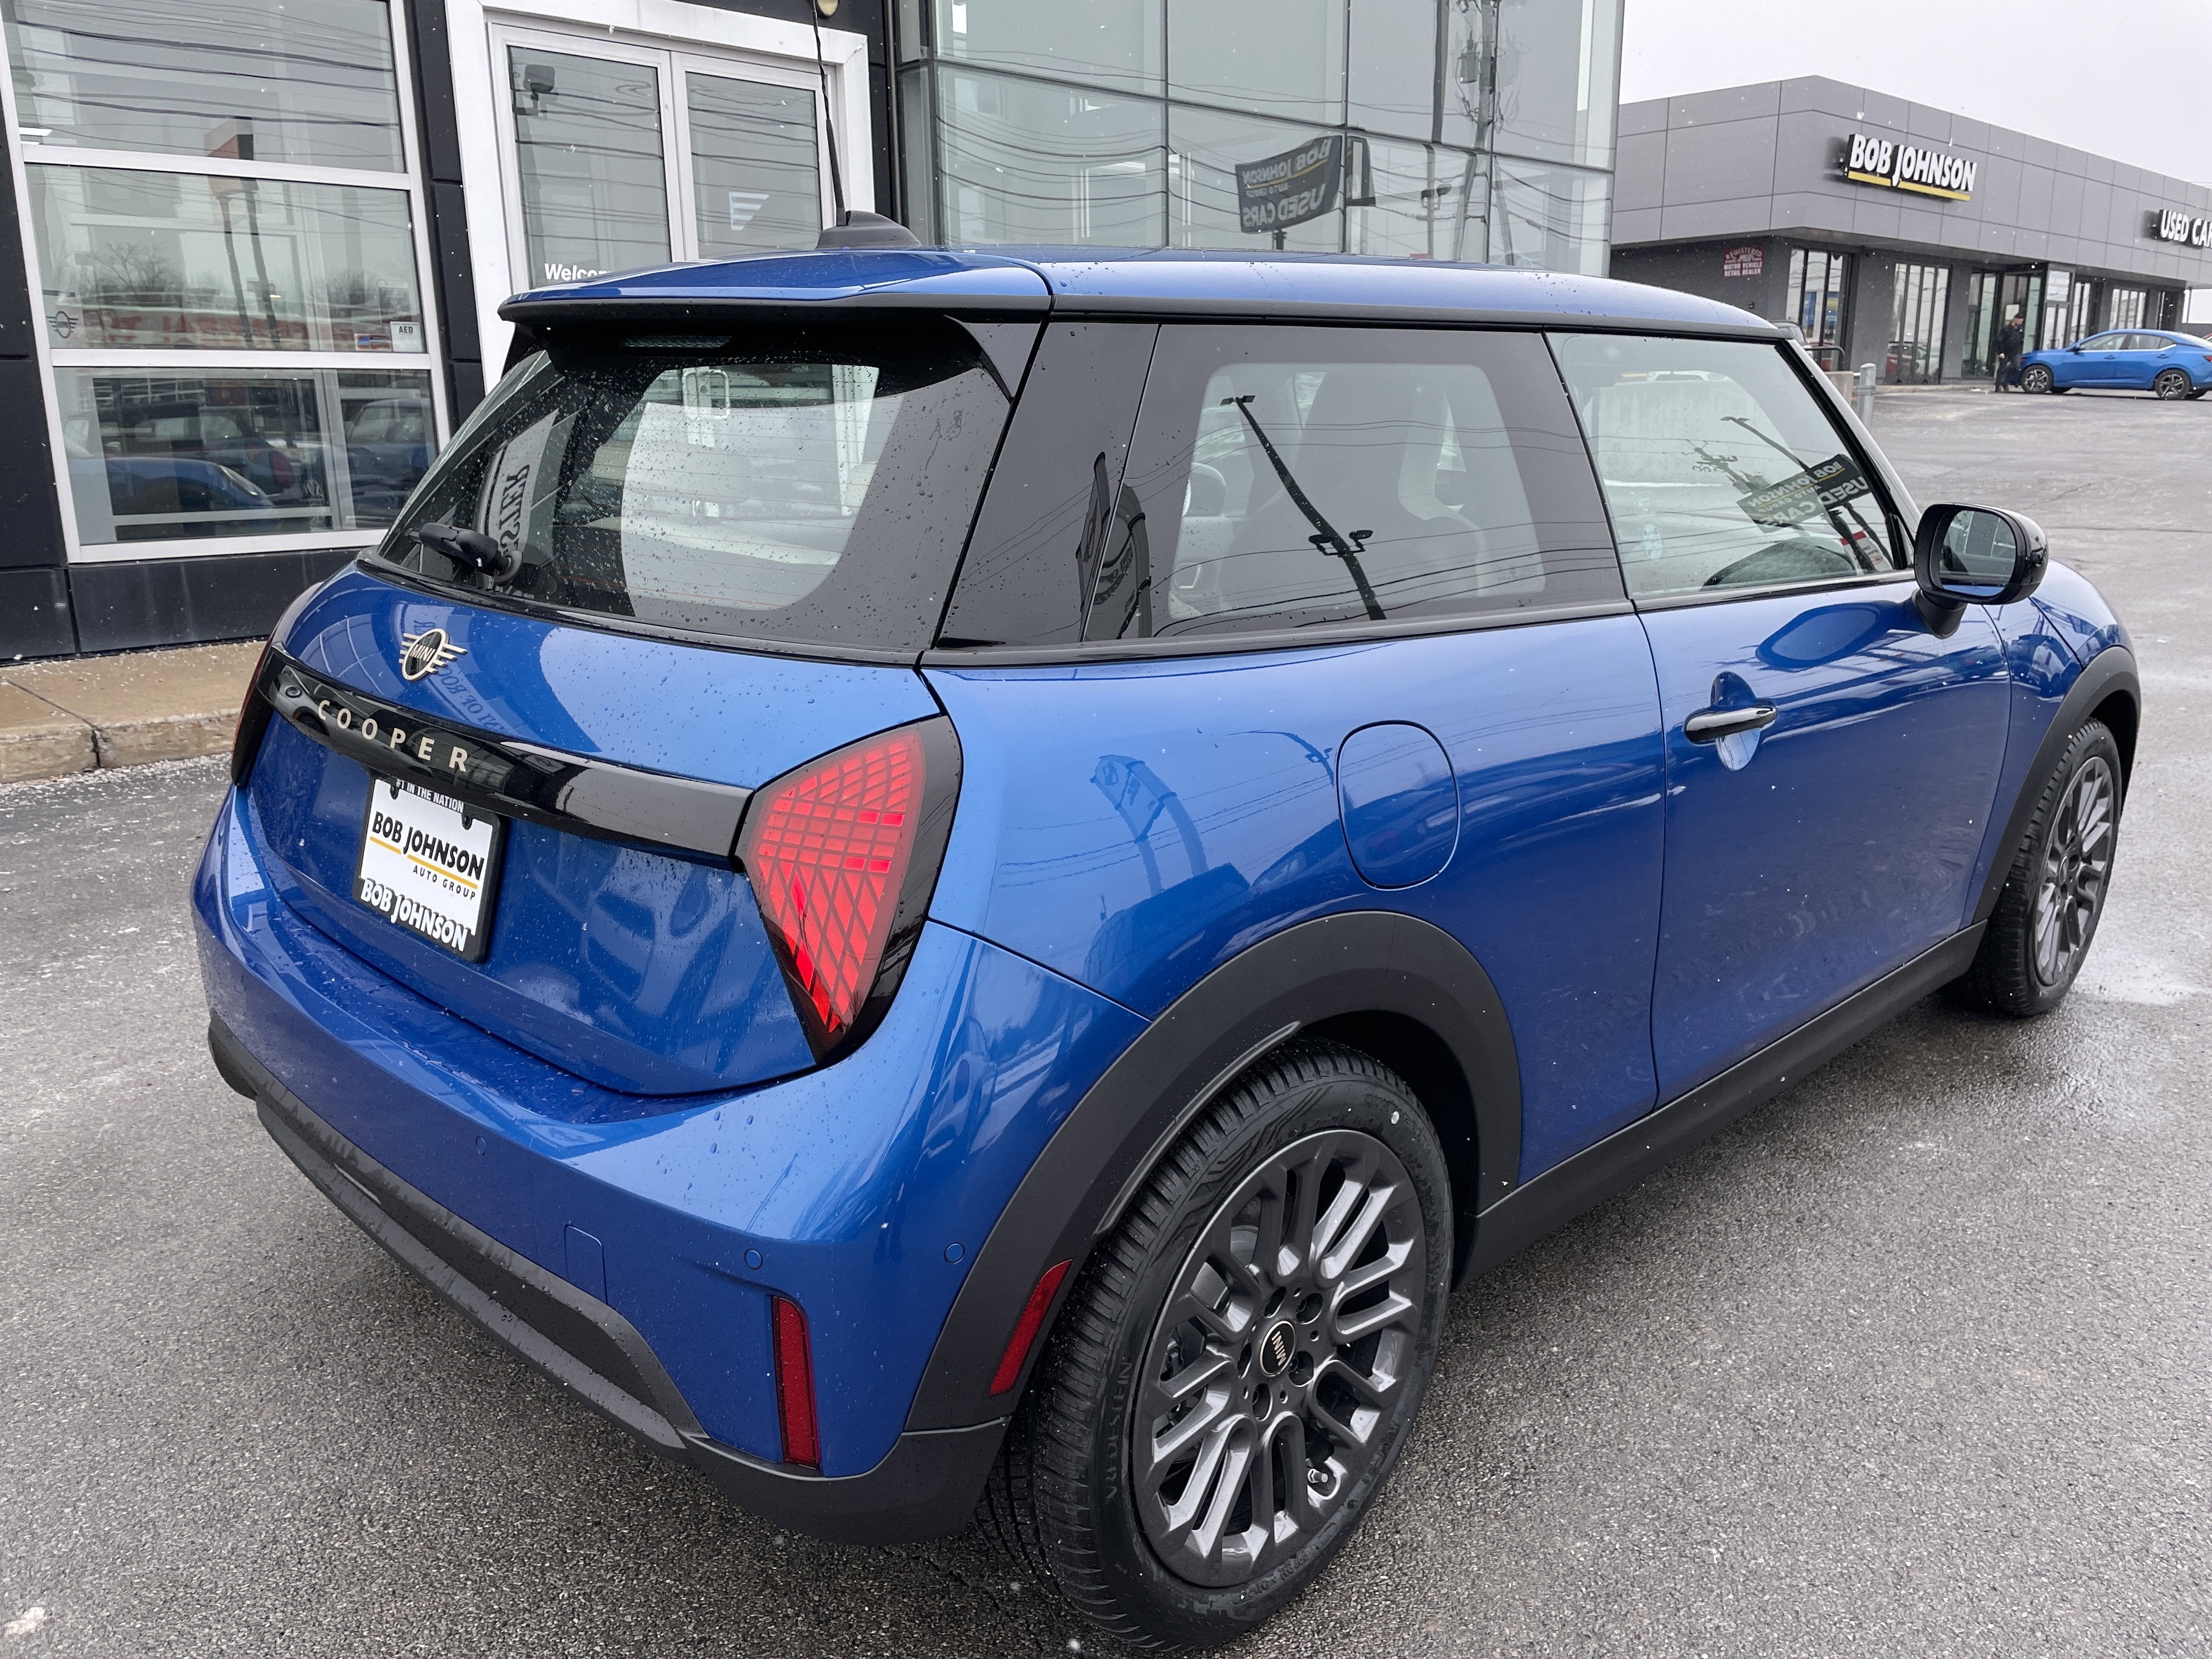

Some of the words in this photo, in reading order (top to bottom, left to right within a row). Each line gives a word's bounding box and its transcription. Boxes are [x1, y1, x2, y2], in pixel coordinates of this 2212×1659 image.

[1849, 133, 1892, 174] BOB
[1892, 144, 1977, 191] JOHNSON
[2160, 209, 2189, 242] USED
[410, 644, 436, 662] MINI
[318, 699, 468, 772] COOPER
[396, 778, 405, 789] #1
[407, 780, 415, 794] IN
[417, 785, 431, 800] THE
[433, 791, 465, 813] NATION
[372, 811, 403, 843] BOB
[403, 826, 485, 881] JOHNSON
[413, 865, 437, 883] AUTO
[443, 878, 476, 900] GROUP
[360, 878, 394, 912] BOB
[391, 894, 470, 952] JOHNSON
[1272, 1330, 1286, 1366] MINI
[1105, 1363, 1132, 1504] VDESTEIN
